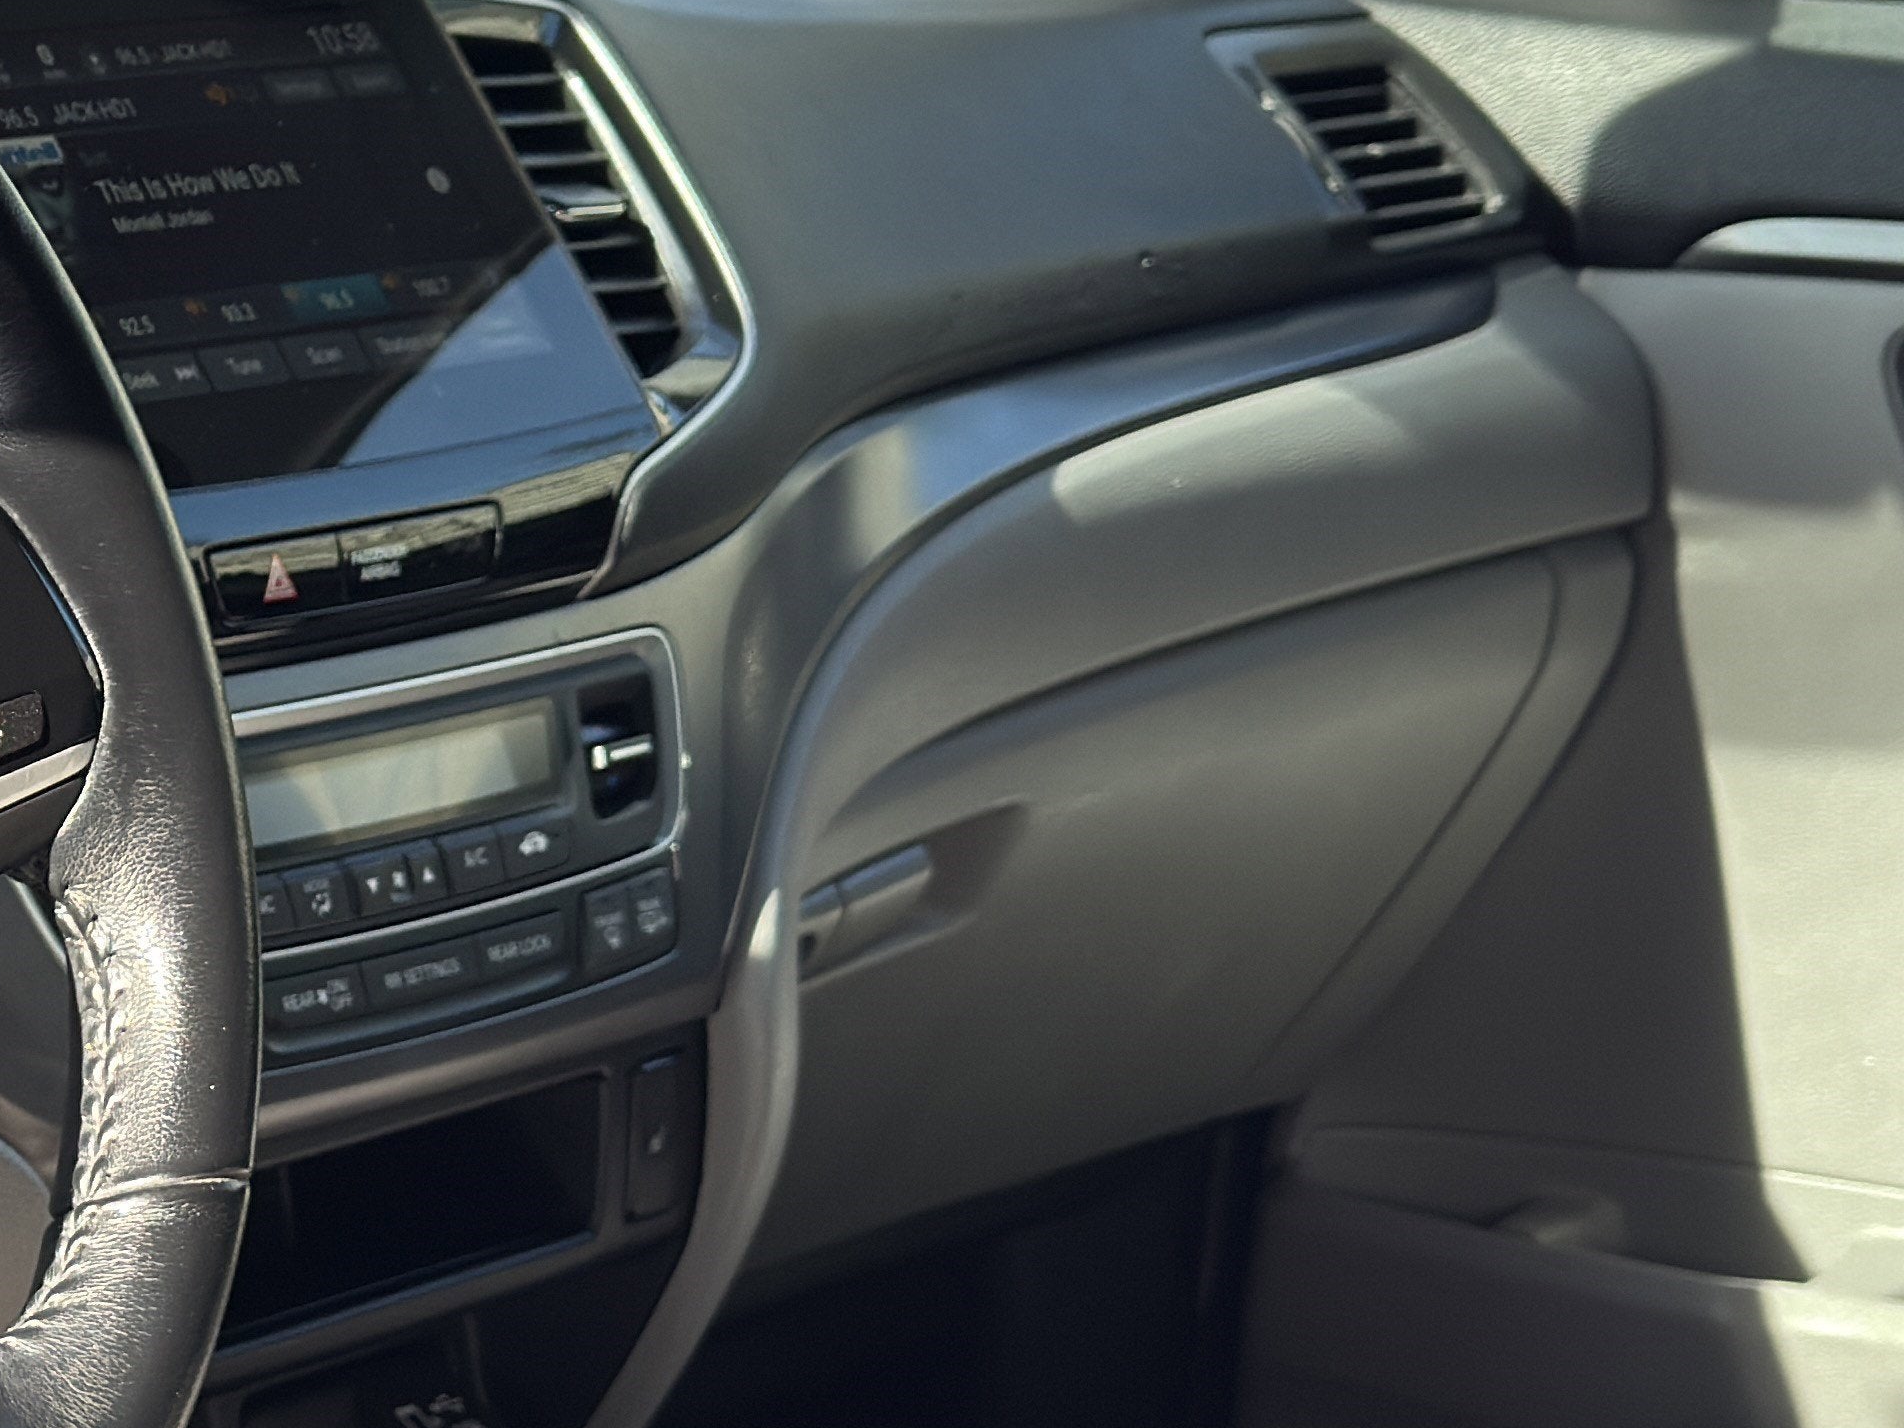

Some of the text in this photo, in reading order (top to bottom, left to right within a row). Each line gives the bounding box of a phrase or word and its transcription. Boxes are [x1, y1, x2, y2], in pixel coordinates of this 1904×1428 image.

[92, 176, 145, 204] This
[164, 172, 216, 198] How
[248, 162, 283, 189] Do
